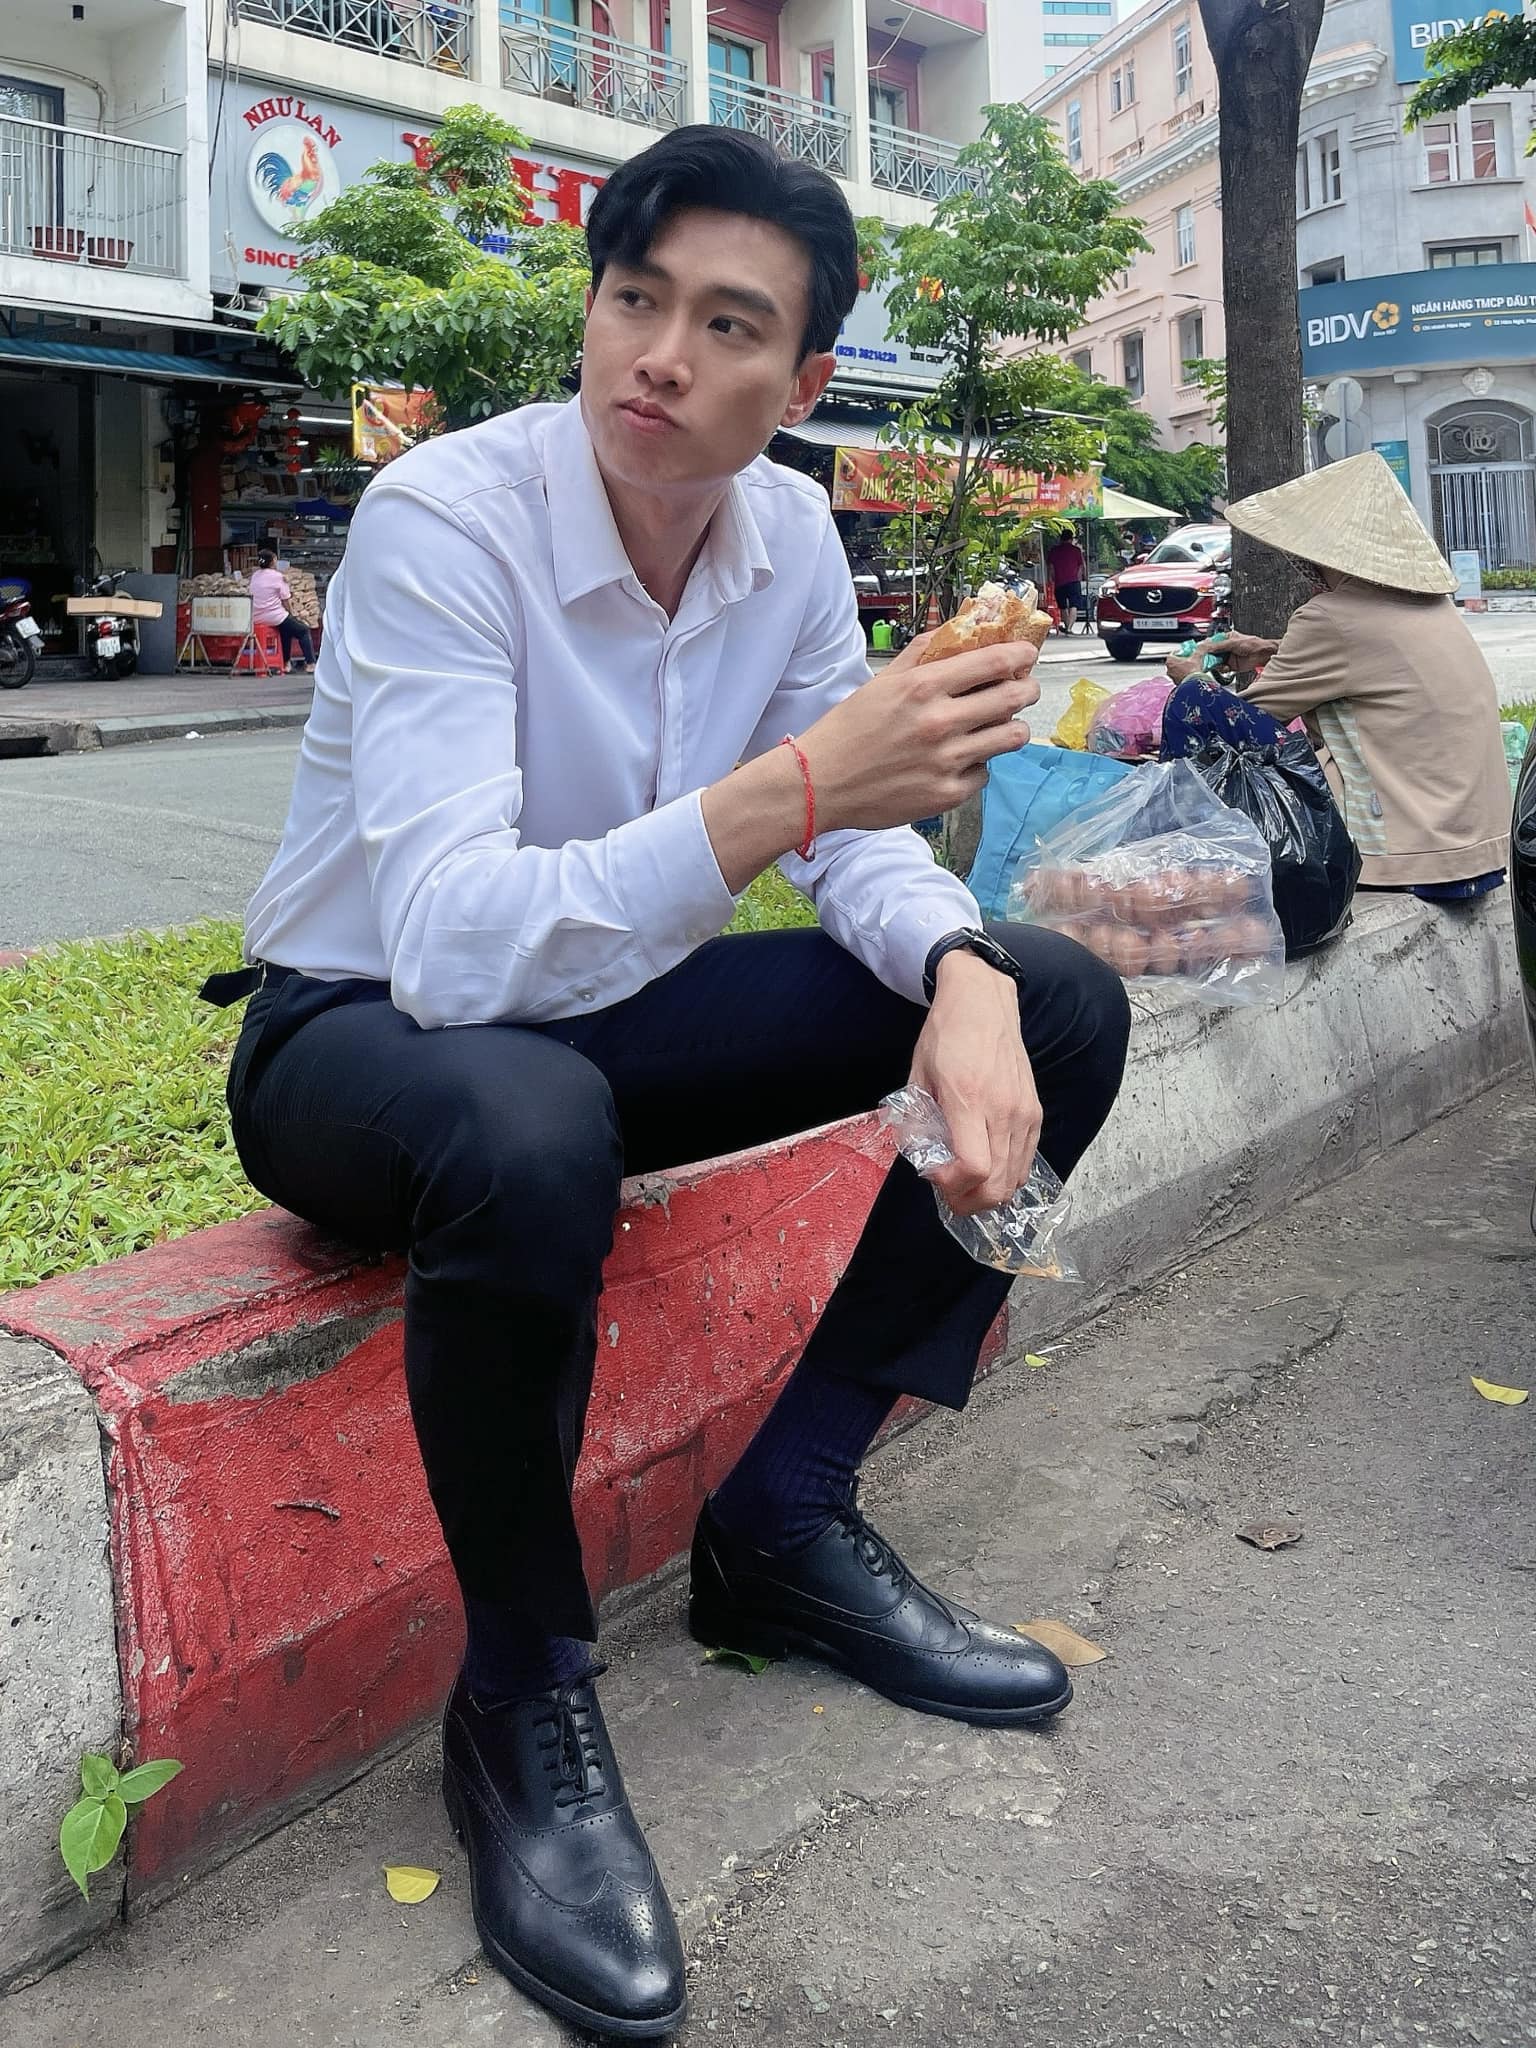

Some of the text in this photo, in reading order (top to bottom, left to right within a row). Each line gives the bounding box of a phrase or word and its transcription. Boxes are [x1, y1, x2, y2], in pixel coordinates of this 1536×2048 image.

[243, 96, 342, 149] NHƯ LAN
[244, 247, 298, 270] SINCE
[1474, 297, 1505, 310] TMCP
[1307, 309, 1373, 347] BIDV
